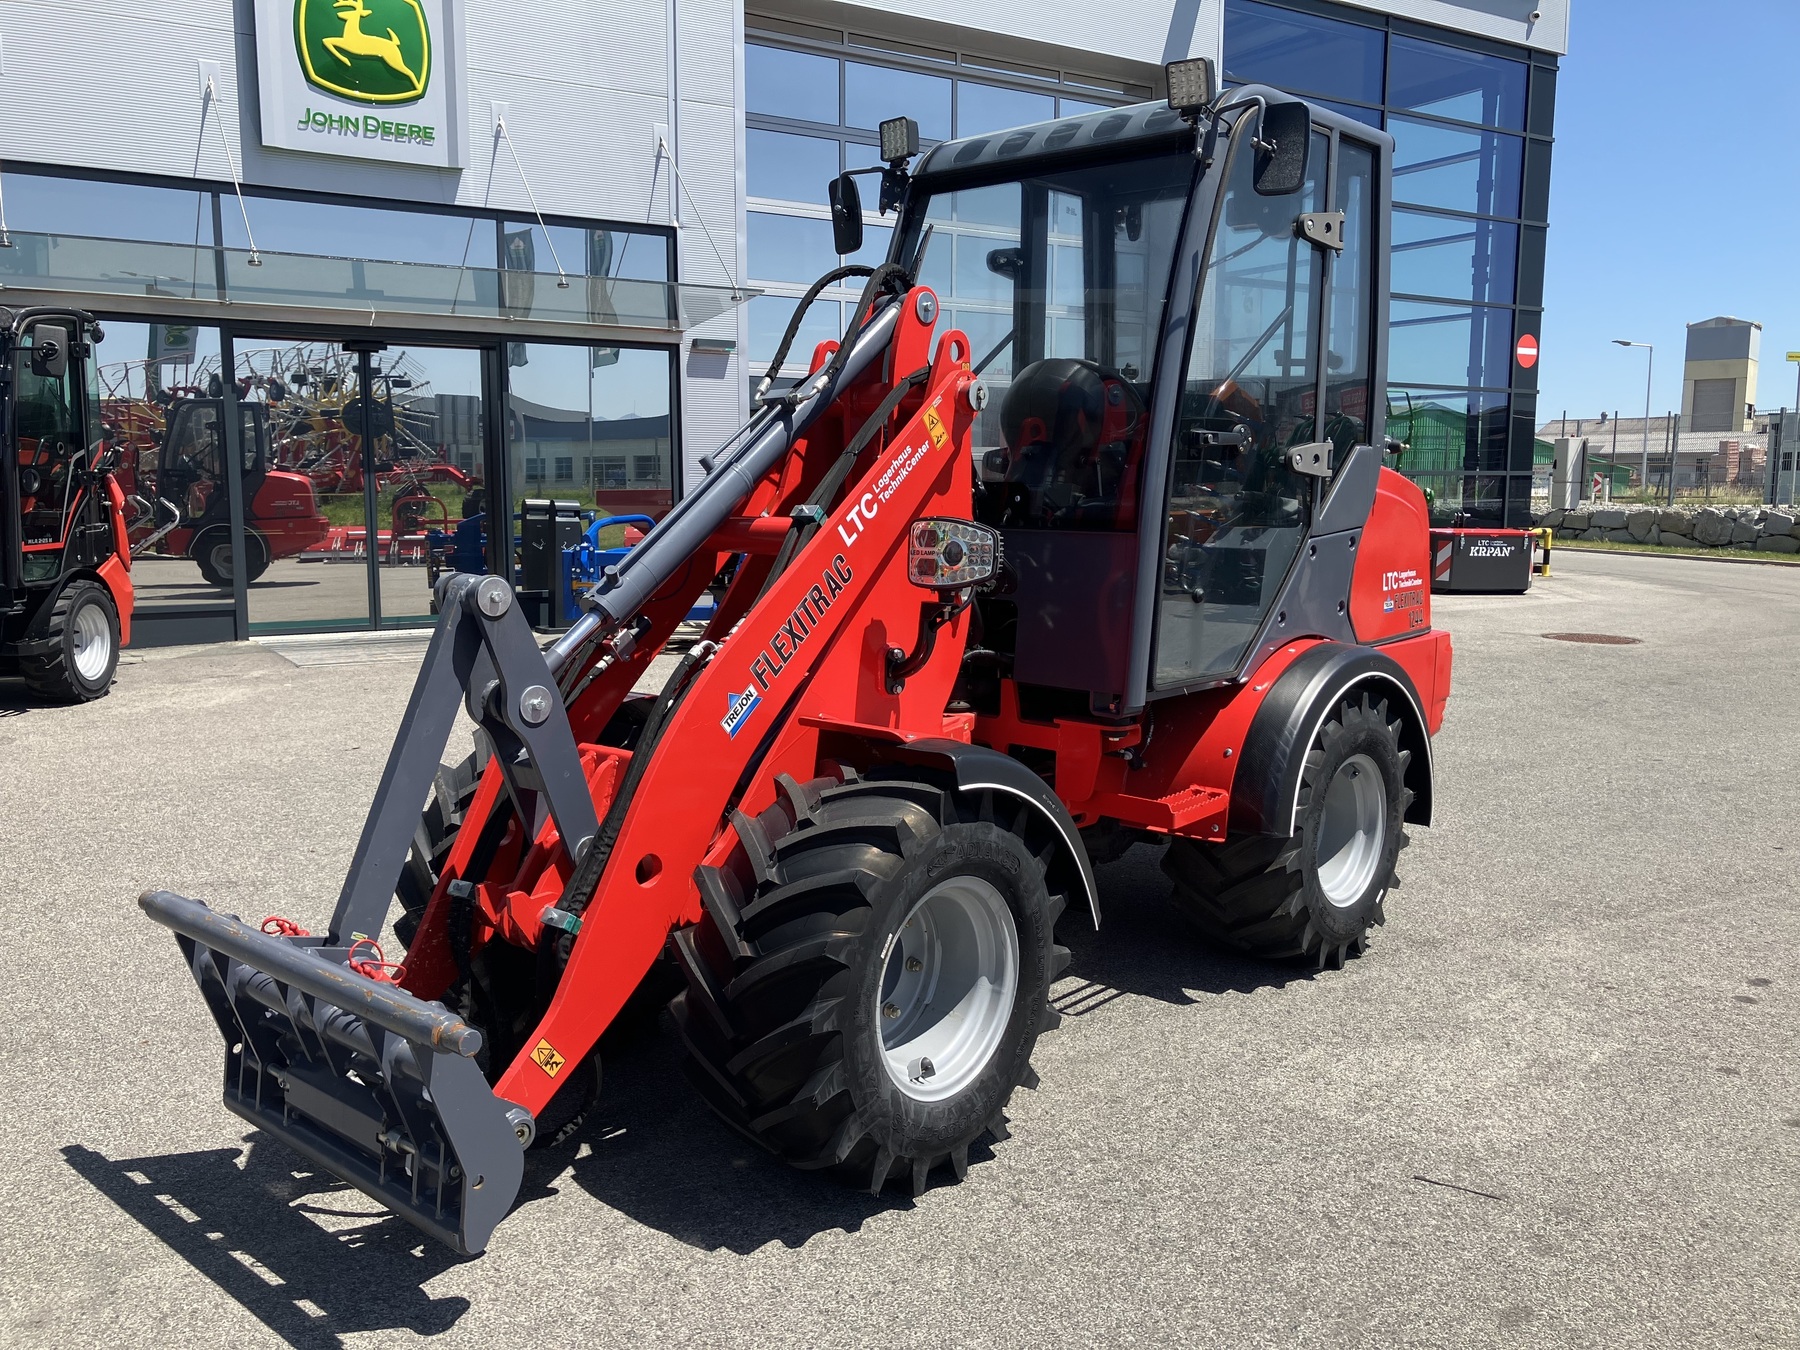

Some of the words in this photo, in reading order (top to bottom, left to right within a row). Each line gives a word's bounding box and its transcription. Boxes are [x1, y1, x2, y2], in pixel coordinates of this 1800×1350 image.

[298, 107, 360, 132] JOHN
[363, 115, 436, 141] DEERE
[872, 444, 912, 493] Lagerhaus
[877, 439, 931, 504] TechnikCenter
[836, 491, 879, 548] LTC
[1469, 546, 1511, 557] KRPAN
[1477, 539, 1490, 547] LTC
[1382, 571, 1399, 592] LTC
[749, 553, 854, 692] FLEXITRAC
[1408, 608, 1424, 629] 1244
[723, 689, 755, 728] TREJON
[957, 841, 1019, 875] ADVANCE
